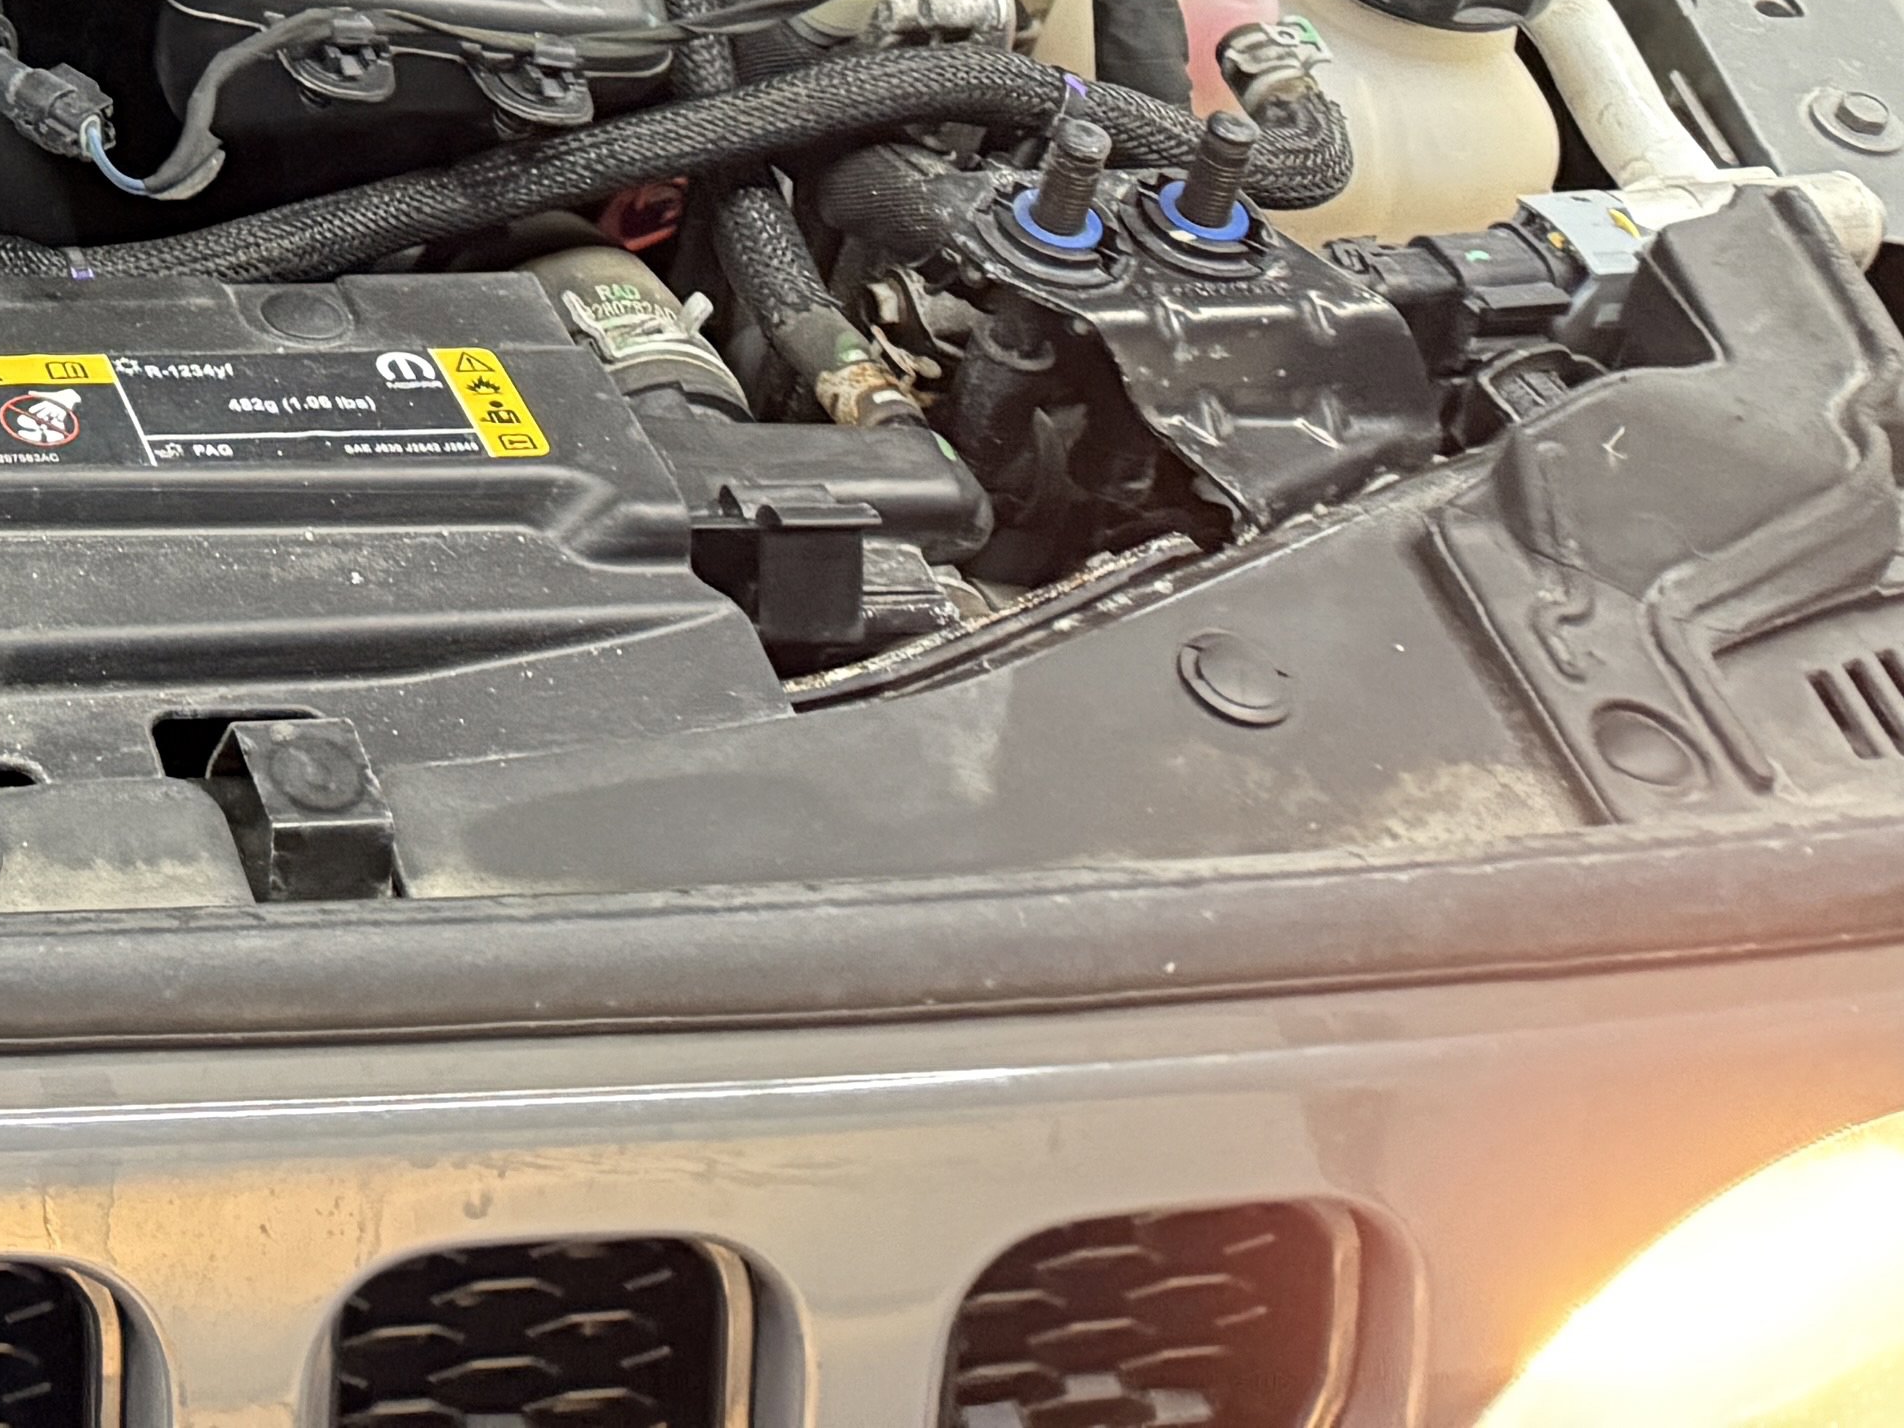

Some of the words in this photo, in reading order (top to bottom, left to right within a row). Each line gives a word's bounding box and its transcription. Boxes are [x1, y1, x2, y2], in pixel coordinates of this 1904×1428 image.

[594, 284, 641, 301] RAD
[144, 362, 234, 380] R-1234yf
[334, 395, 377, 412] lbs)
[192, 444, 234, 458] PAG
